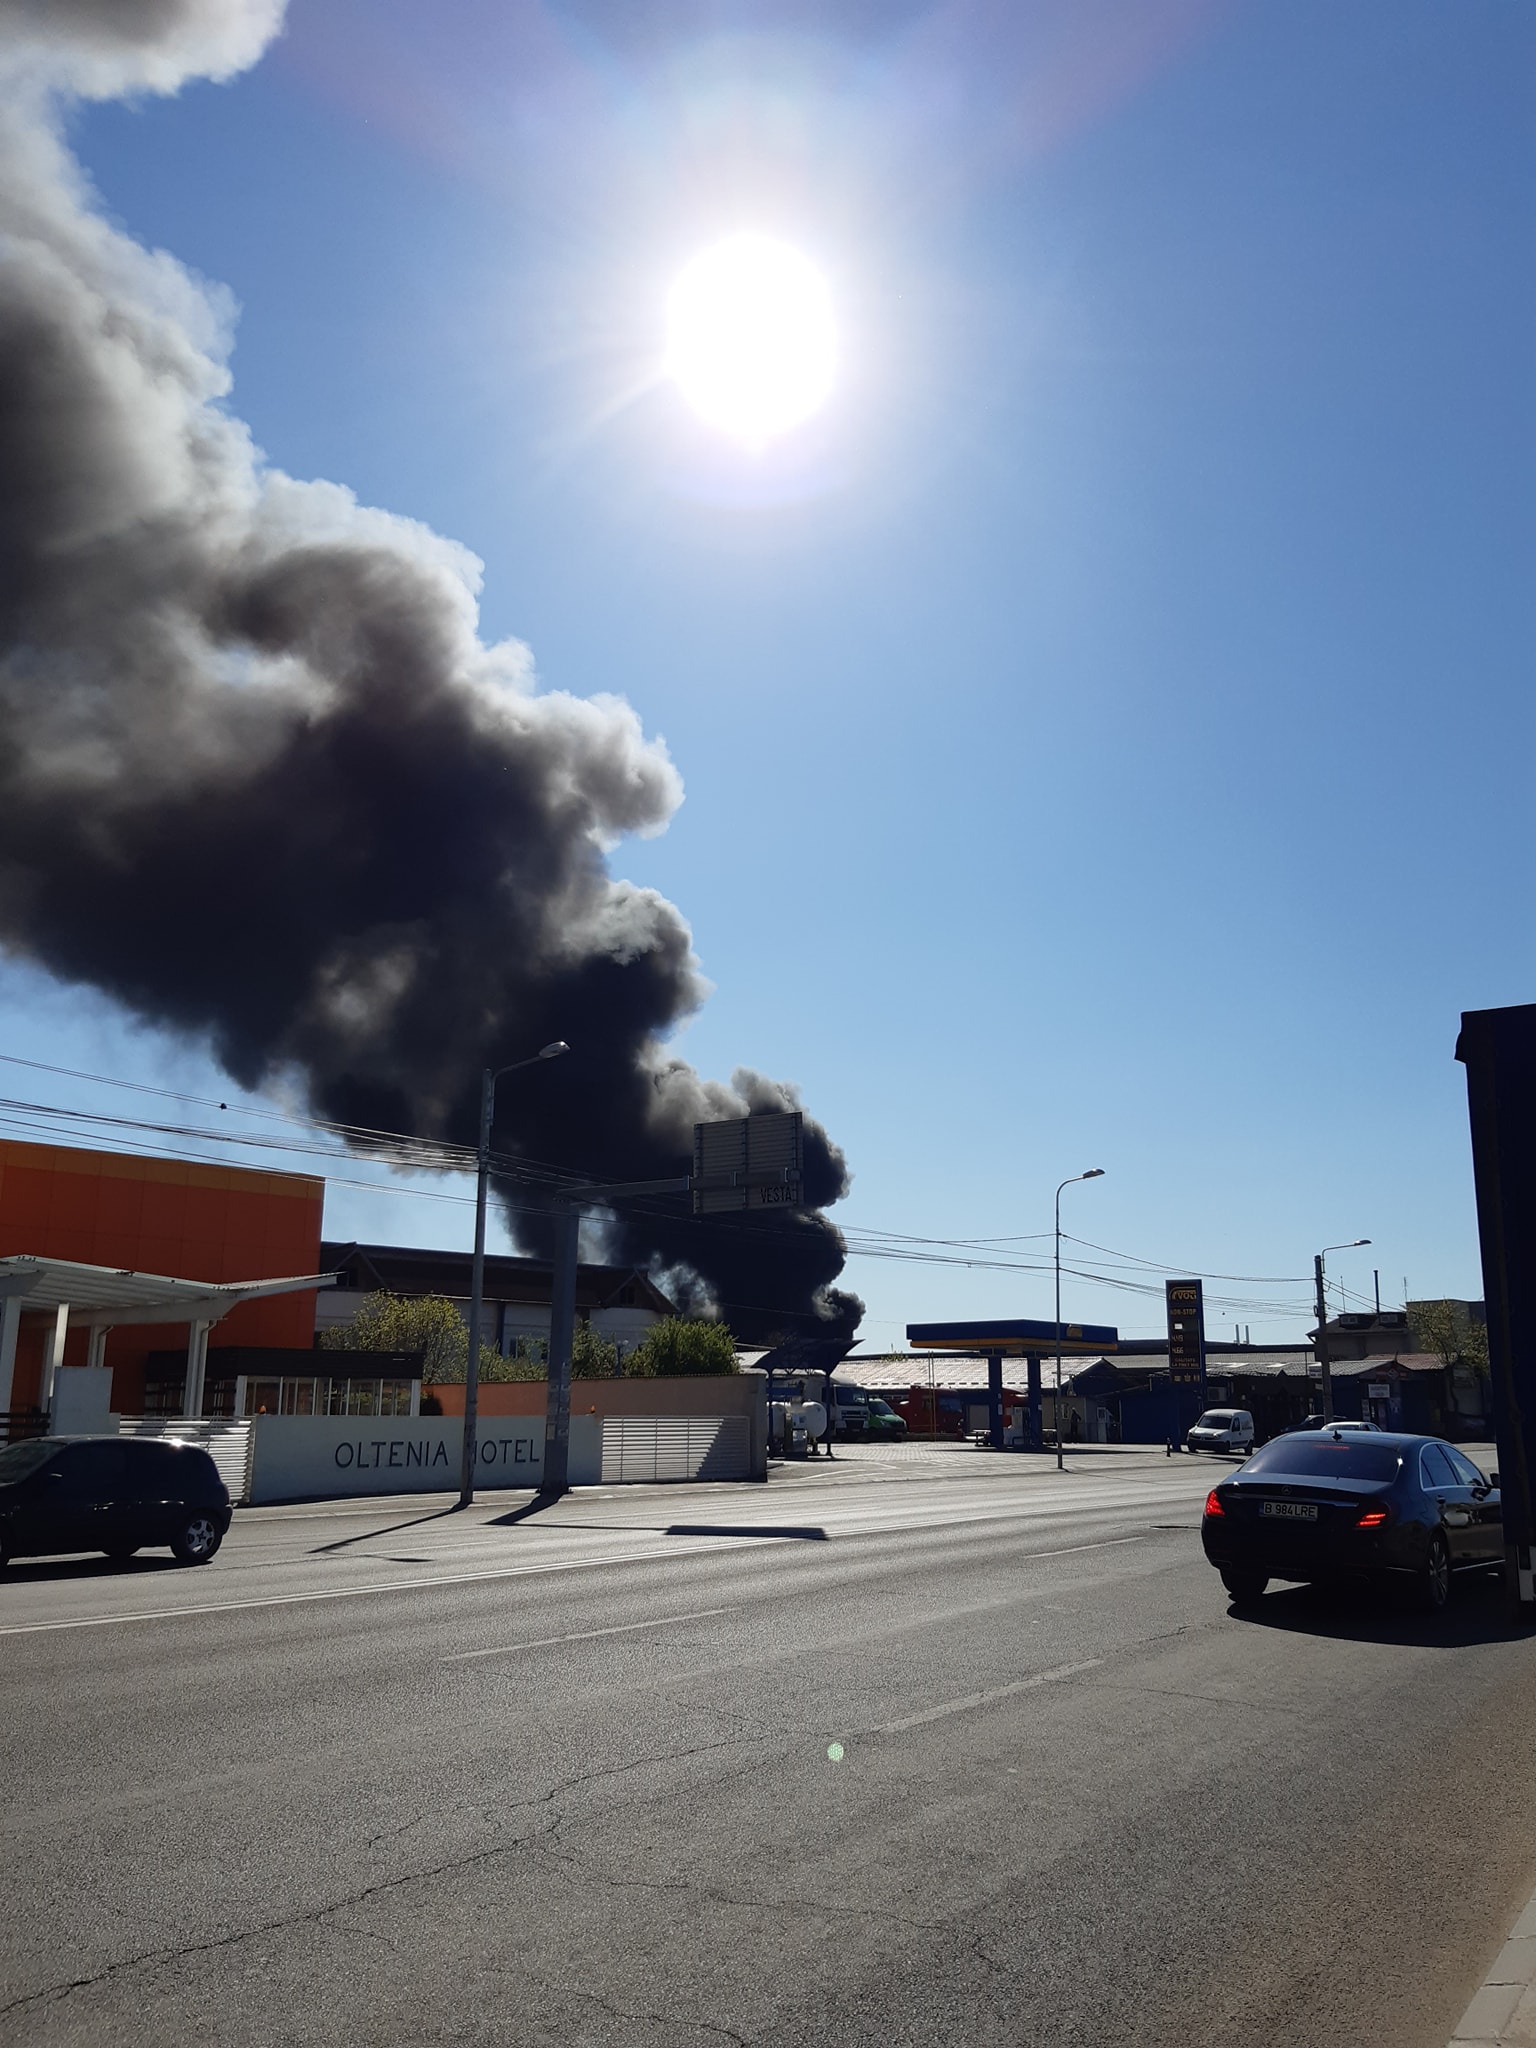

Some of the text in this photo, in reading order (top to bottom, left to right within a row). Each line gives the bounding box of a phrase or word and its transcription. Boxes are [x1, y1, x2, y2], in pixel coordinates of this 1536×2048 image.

[760, 1186, 792, 1203] VESTA
[334, 1440, 449, 1469] OLTENIA
[1265, 1503, 1272, 1513] B
